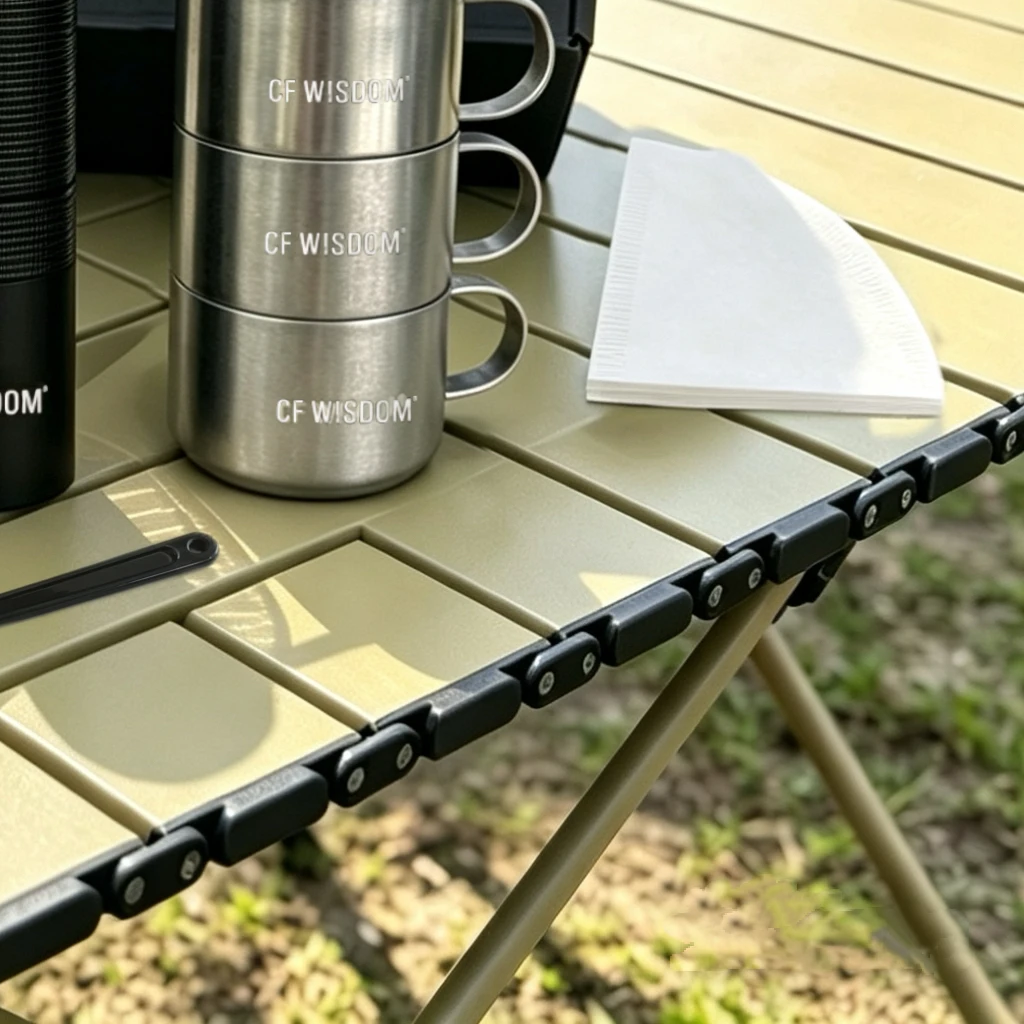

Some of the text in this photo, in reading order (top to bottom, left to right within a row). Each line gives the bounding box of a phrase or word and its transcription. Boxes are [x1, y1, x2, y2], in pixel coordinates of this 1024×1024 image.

[268, 79, 296, 103] CF
[264, 231, 292, 255] CF
[276, 399, 303, 424] CF
